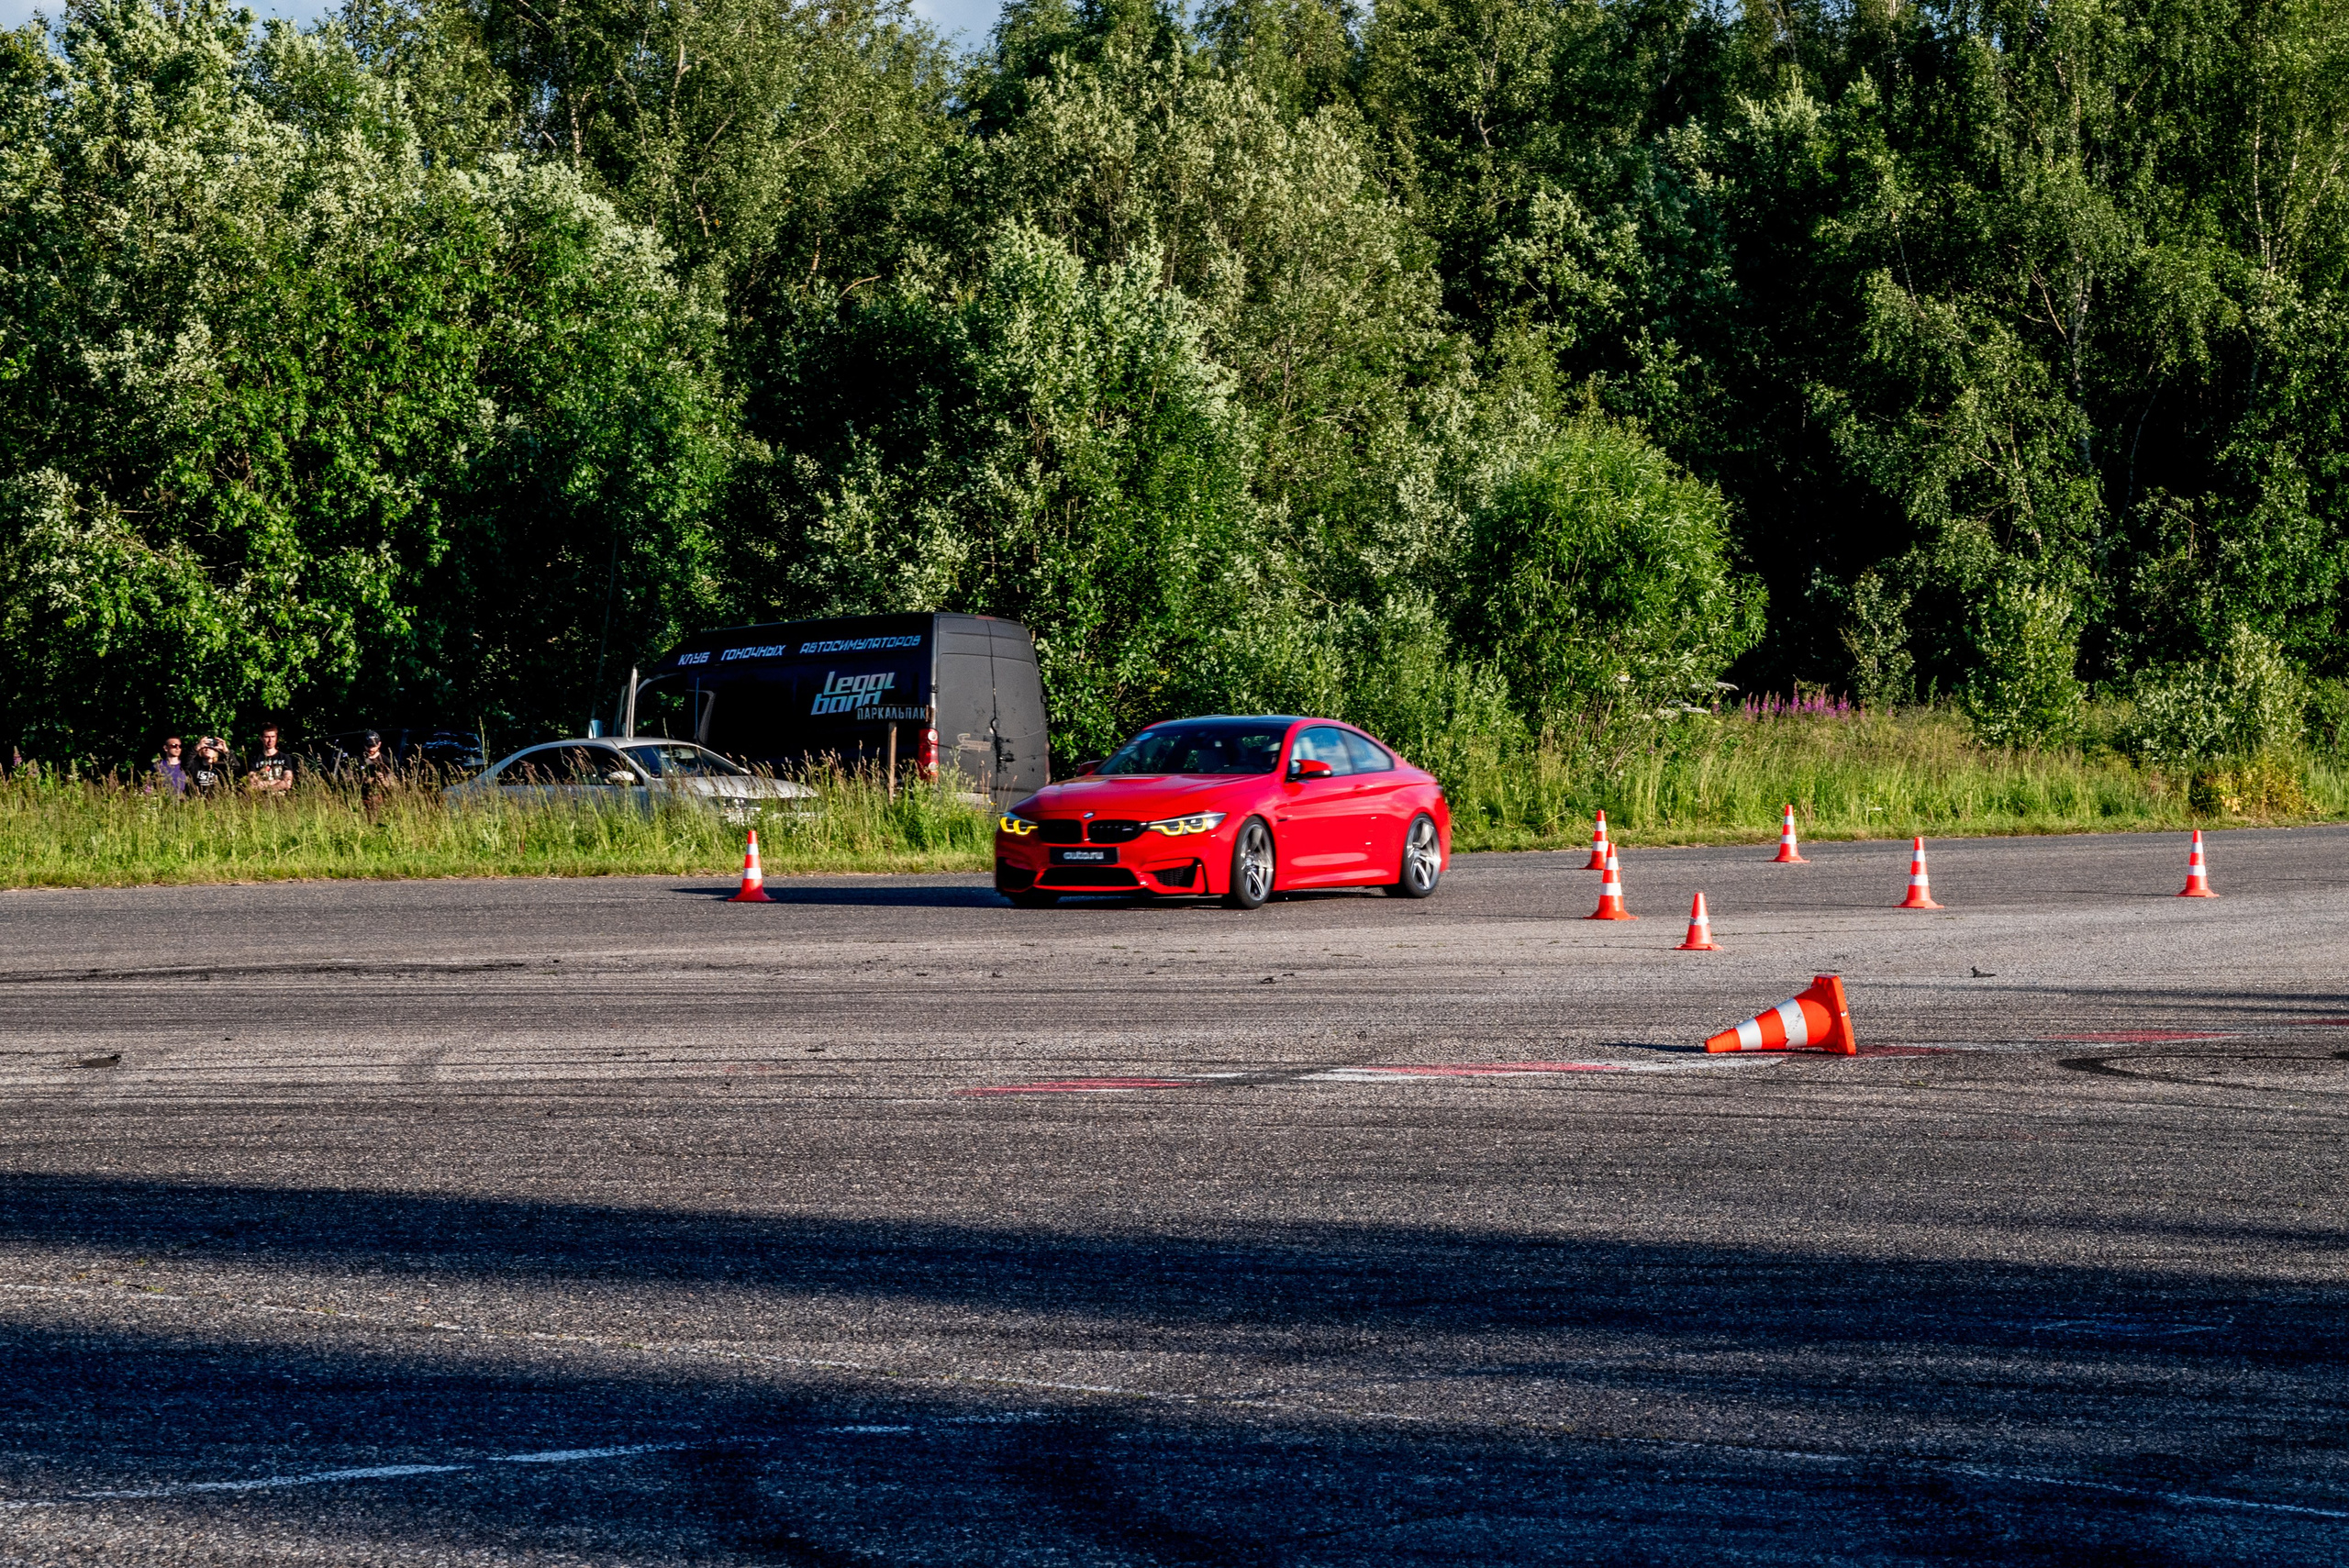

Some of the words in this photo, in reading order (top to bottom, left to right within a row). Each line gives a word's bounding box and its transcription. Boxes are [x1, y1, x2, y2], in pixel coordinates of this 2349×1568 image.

[678, 652, 711, 665] КЛУБ
[720, 644, 786, 661] ГОНОЧНЫХ
[823, 671, 896, 700] Legal
